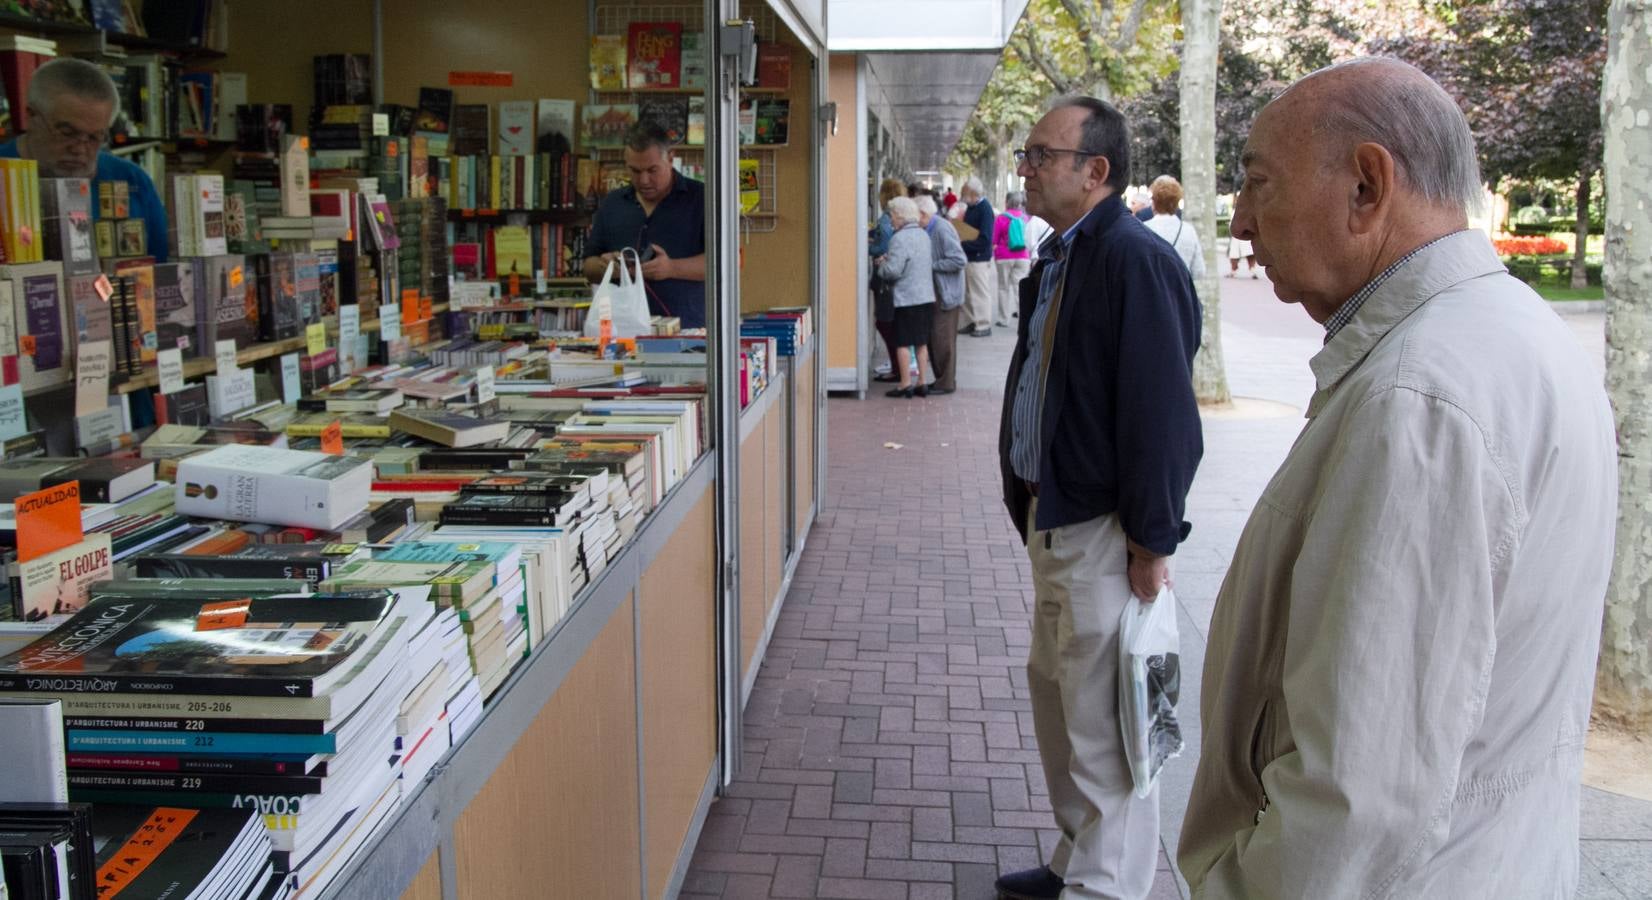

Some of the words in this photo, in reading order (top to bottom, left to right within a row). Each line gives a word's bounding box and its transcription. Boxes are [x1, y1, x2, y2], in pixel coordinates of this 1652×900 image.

[236, 475, 246, 504] GRAN
[18, 486, 78, 514] ACTUALIDAD
[245, 477, 254, 518] GUERRA
[235, 506, 242, 517] LA
[60, 560, 74, 581] EL
[75, 547, 108, 576] GOLPE
[285, 684, 299, 694] 4
[67, 701, 131, 710] D'ARQUITECTURA
[137, 703, 181, 711] URBANISME
[187, 702, 232, 712] 205-206
[66, 719, 129, 728] D'ARQUITECTURA
[135, 720, 178, 729] URBANISME
[185, 720, 205, 731] 220
[72, 736, 136, 745] D'ARQUITECTURA
[143, 738, 186, 746] URBANISME
[194, 736, 214, 747] 212
[67, 776, 126, 786] 'ARQUITECTURA
[132, 778, 175, 787] URBANISME
[182, 777, 201, 788] 219
